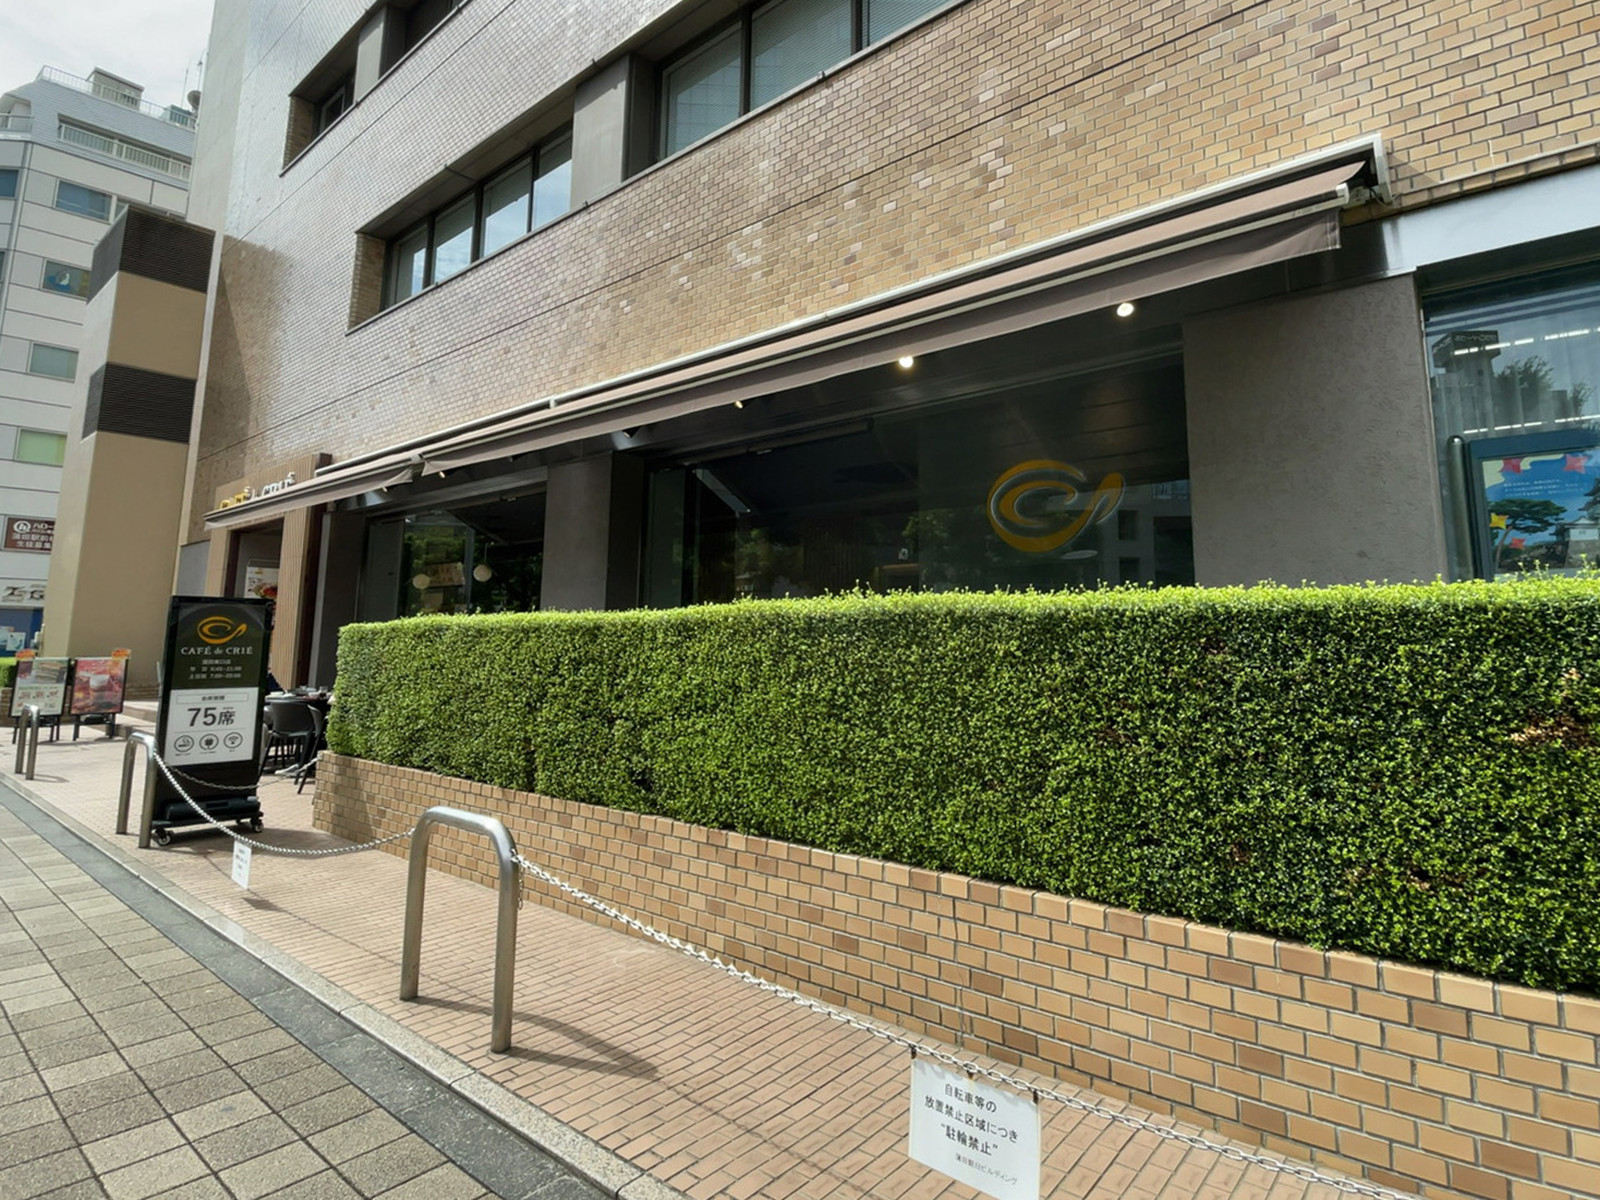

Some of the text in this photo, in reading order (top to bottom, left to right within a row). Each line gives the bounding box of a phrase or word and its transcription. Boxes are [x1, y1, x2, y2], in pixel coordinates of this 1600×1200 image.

[181, 646, 253, 655] CAFÉ de CRIÉ
[944, 1083, 997, 1113] 自転車等の
[924, 1095, 1018, 1143] 放置禁止区域につき
